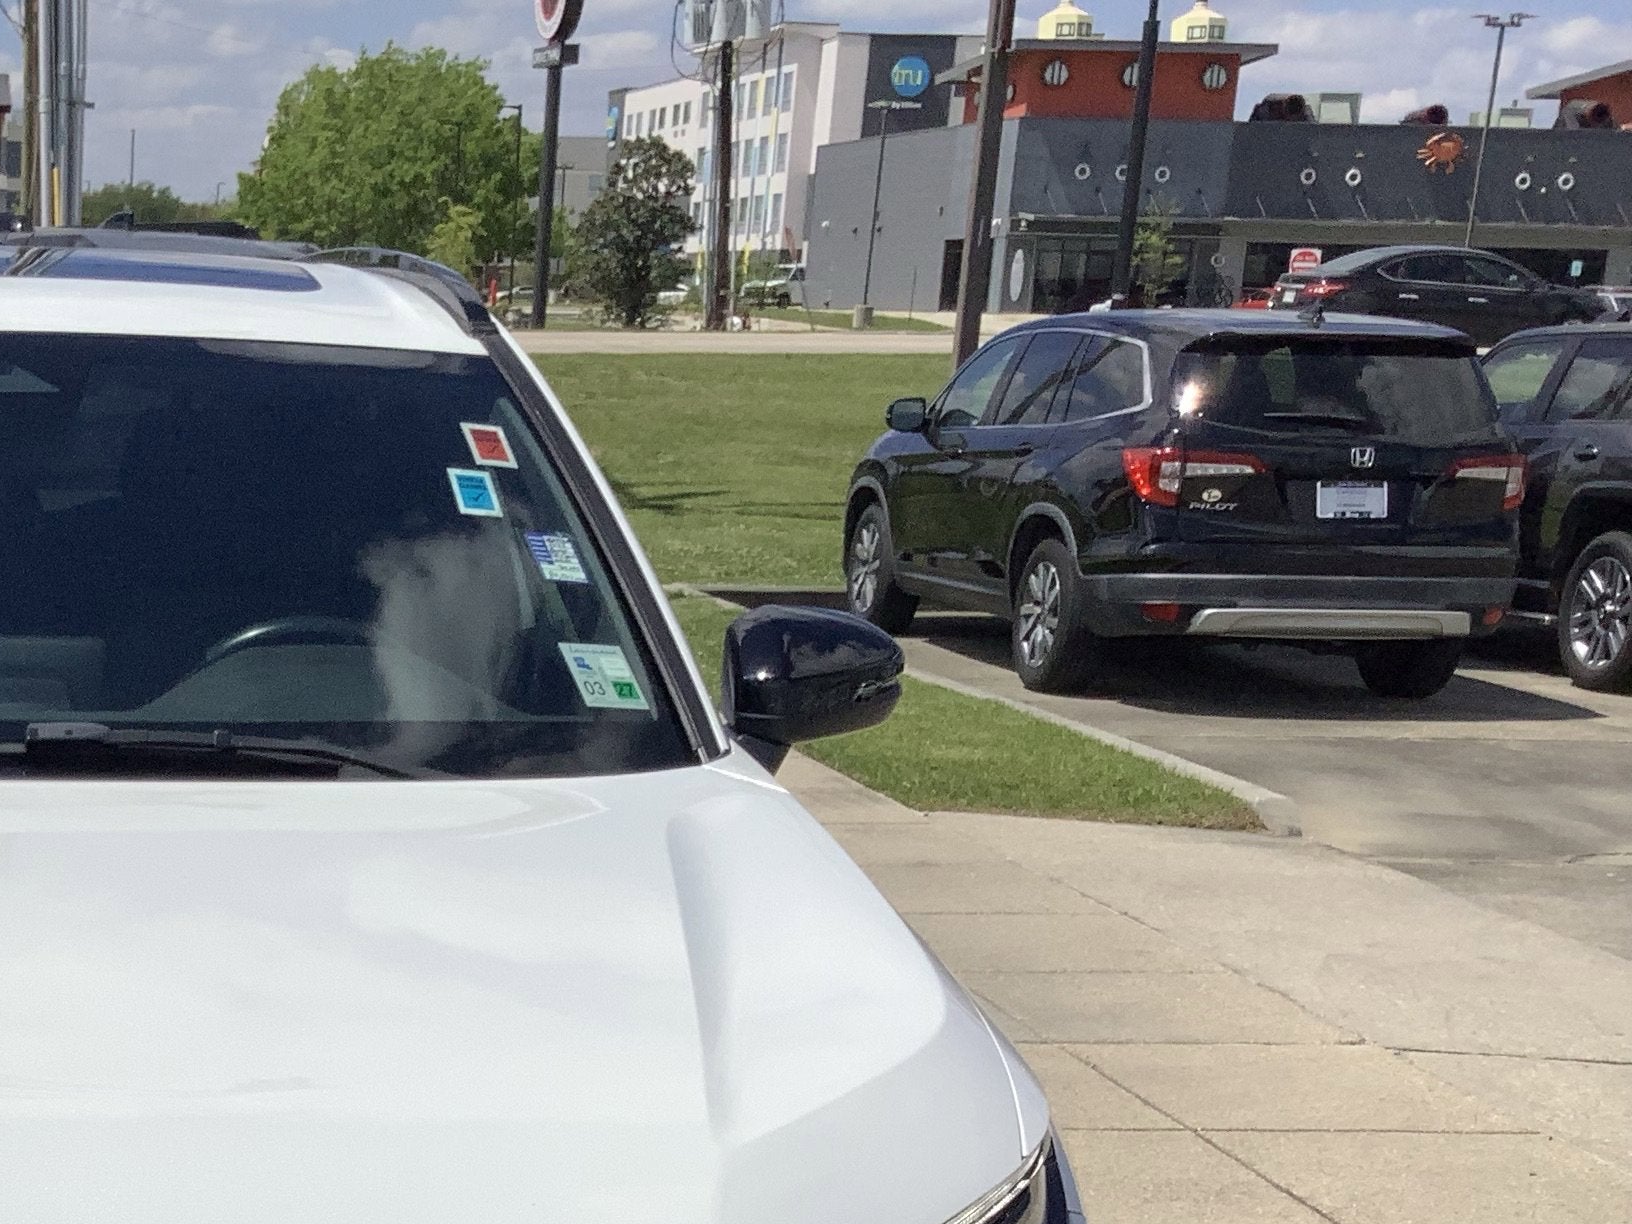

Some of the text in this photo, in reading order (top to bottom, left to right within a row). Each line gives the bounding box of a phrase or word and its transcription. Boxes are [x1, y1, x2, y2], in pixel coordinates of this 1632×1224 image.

[1189, 502, 1237, 511] PILOT
[583, 680, 606, 696] 03
[614, 682, 634, 699] 27
